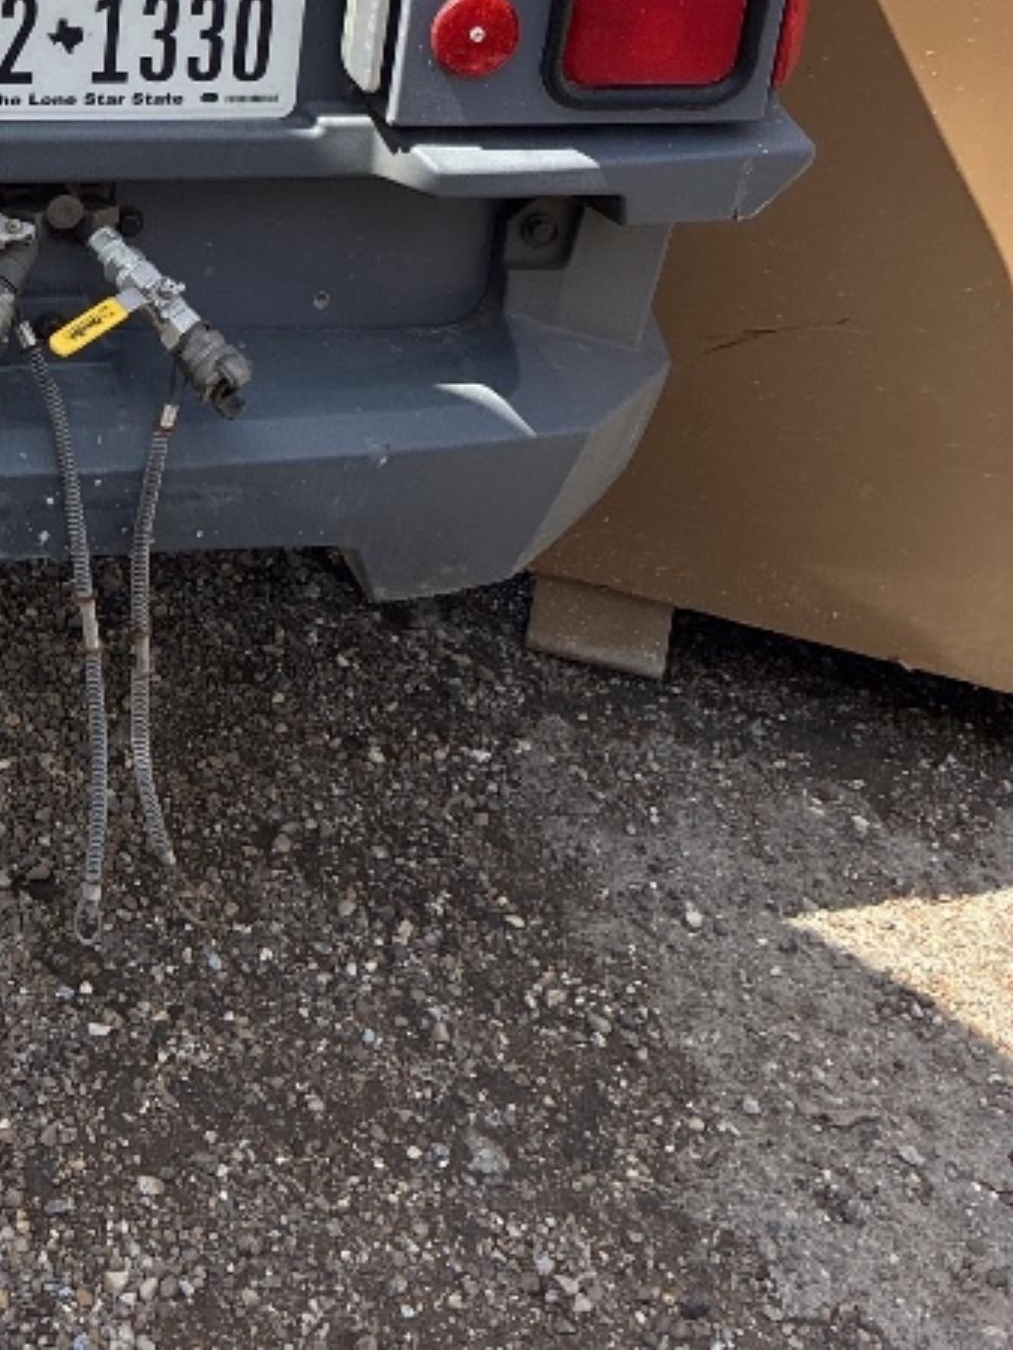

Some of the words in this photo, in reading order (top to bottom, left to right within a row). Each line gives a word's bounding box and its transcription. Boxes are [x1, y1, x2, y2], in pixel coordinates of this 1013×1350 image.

[28, 93, 78, 106] Lone
[84, 92, 126, 106] Star
[132, 92, 184, 106] State
